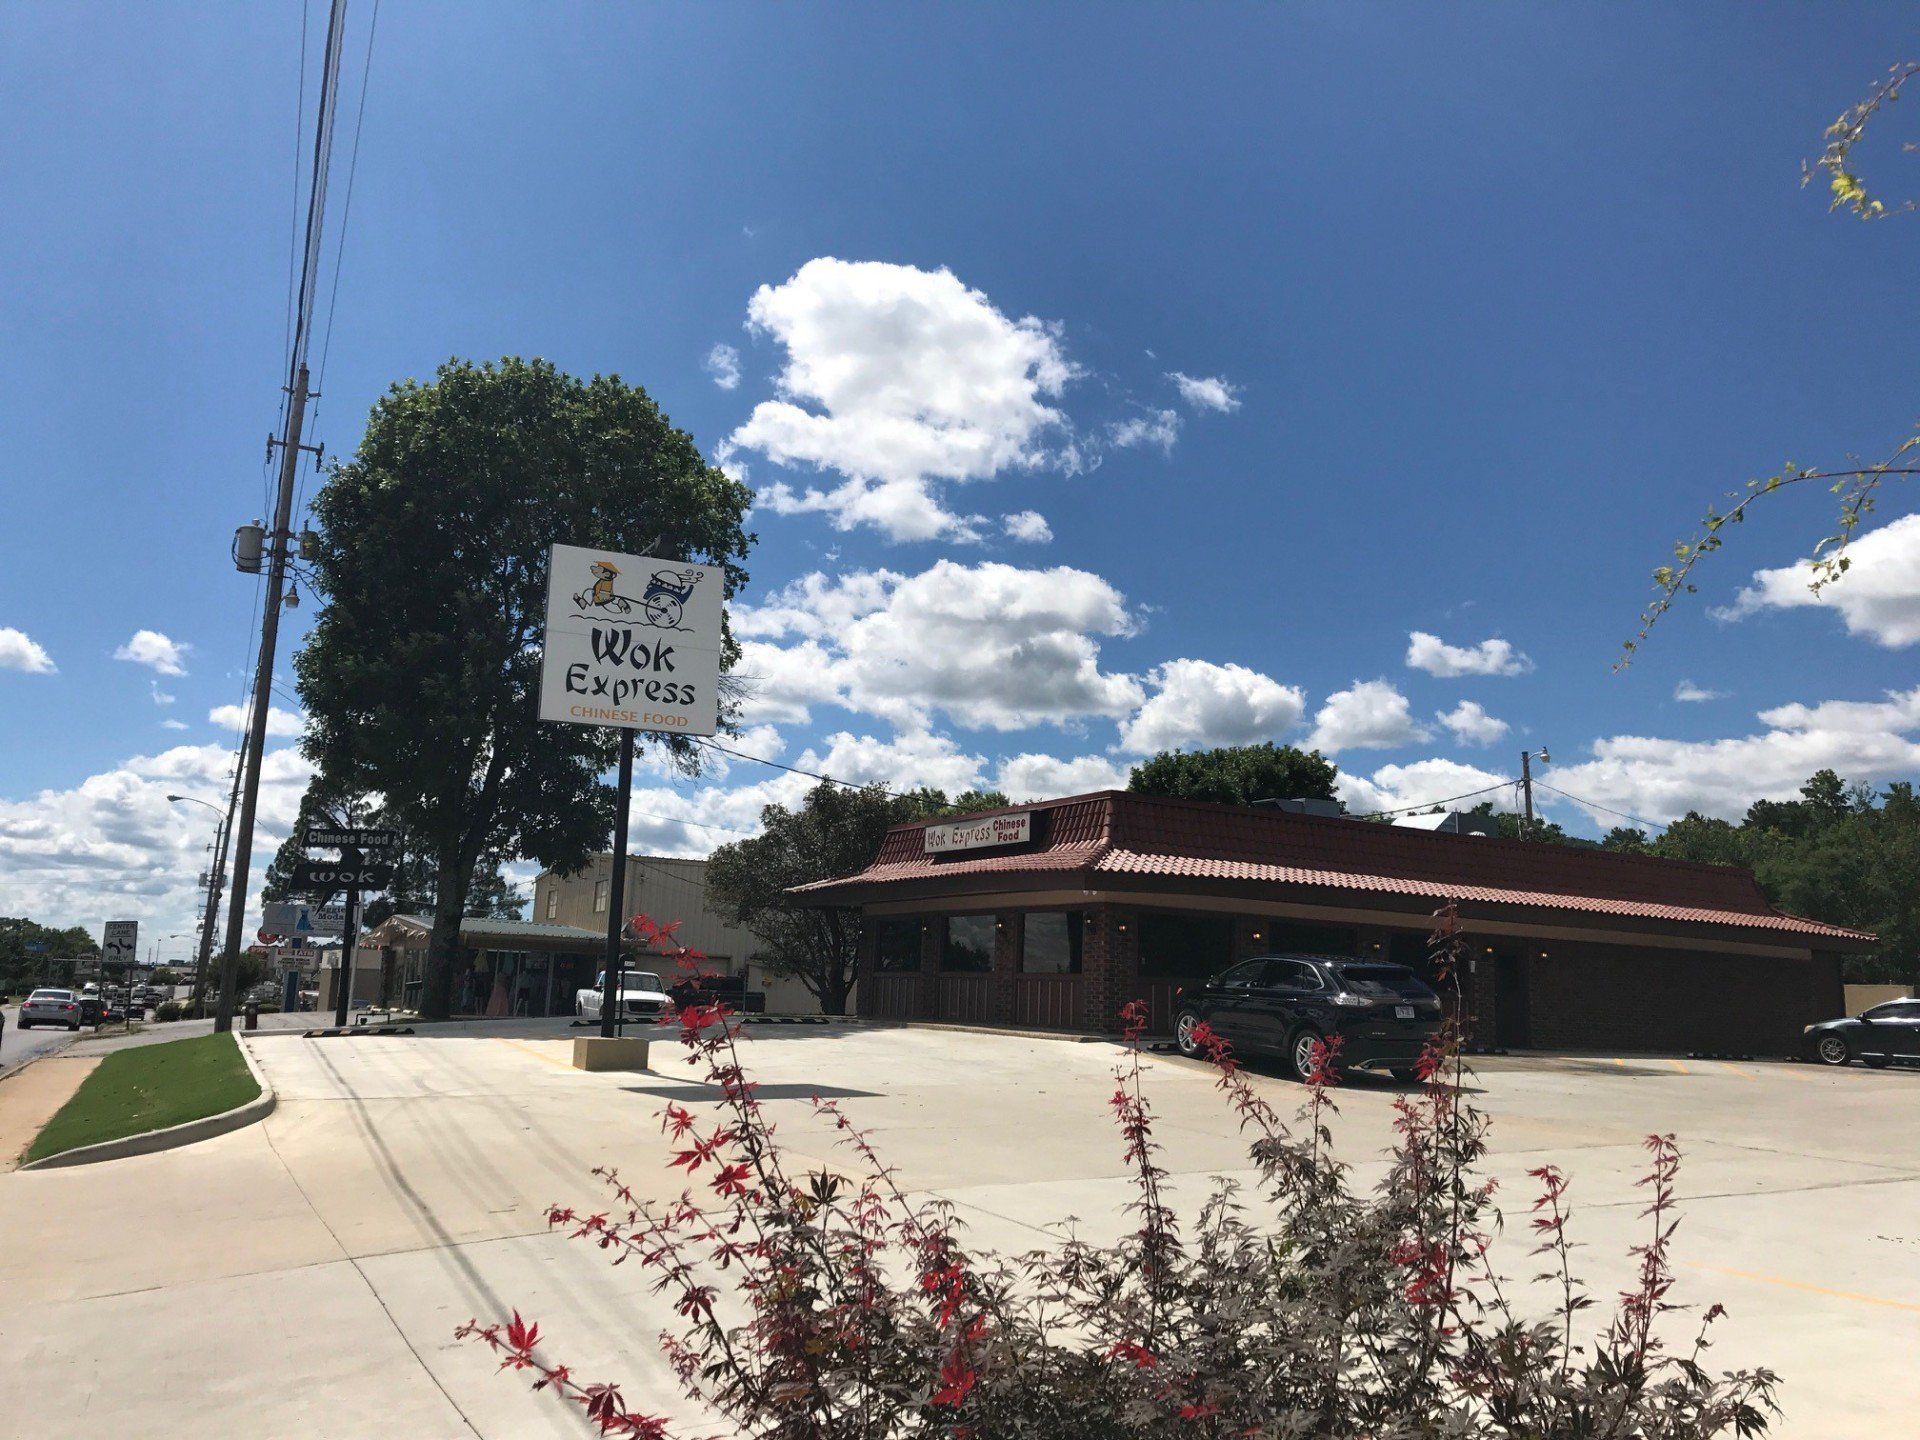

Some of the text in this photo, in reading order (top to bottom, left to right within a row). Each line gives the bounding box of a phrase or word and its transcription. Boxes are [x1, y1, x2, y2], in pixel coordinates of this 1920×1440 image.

[591, 627, 675, 672] Wok
[566, 663, 696, 706] Express
[570, 705, 688, 727] CHINESE FOOD
[992, 818, 1026, 831] Chinese
[308, 831, 389, 845] Chinese Food
[952, 826, 990, 847] Express
[997, 830, 1019, 842] Food
